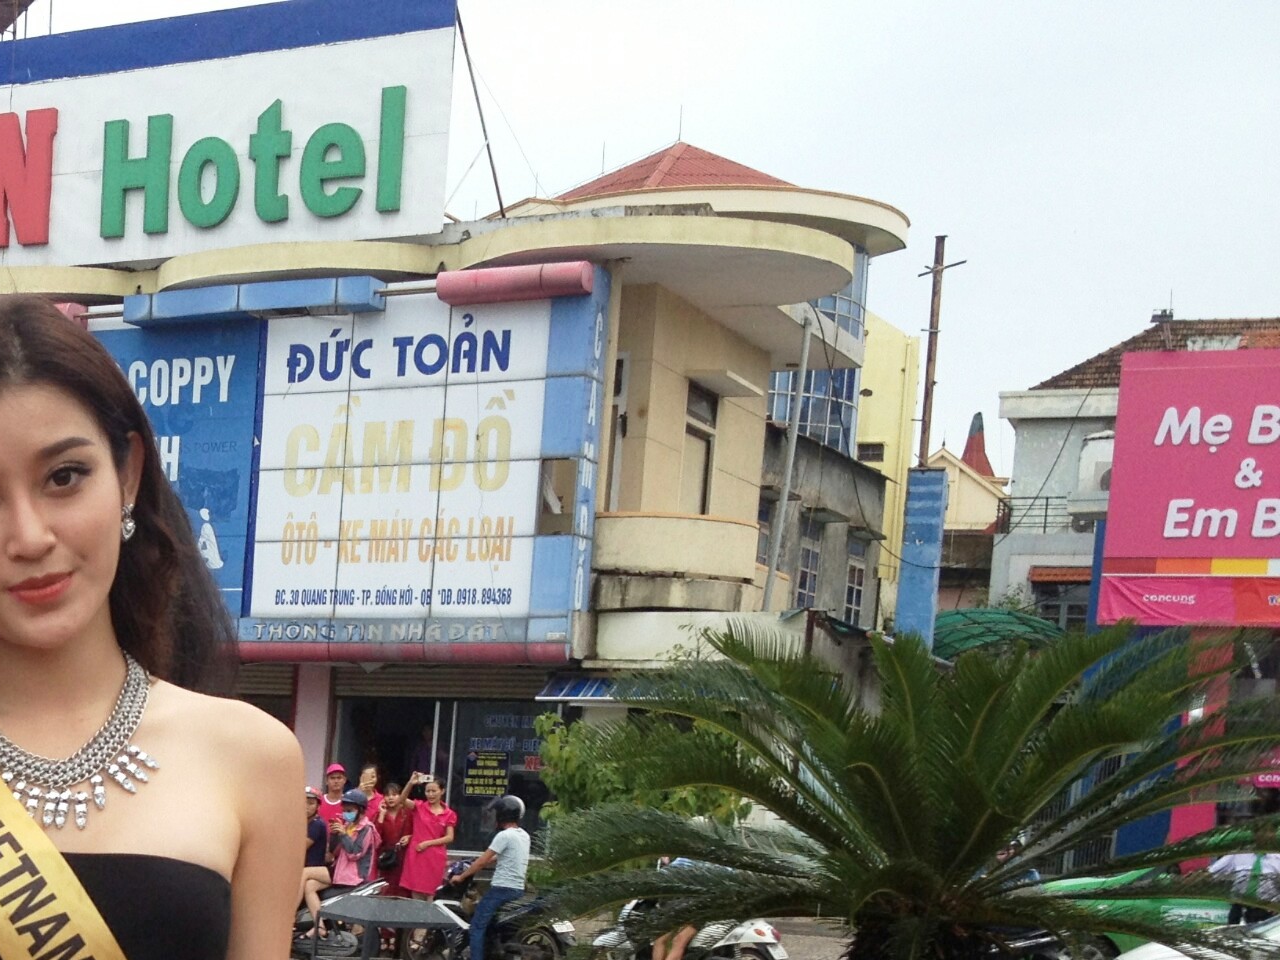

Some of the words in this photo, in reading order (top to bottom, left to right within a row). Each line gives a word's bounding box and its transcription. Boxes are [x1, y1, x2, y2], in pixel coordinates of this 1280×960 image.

[100, 85, 407, 240] Hotel
[286, 328, 374, 384] ĐỨC
[392, 313, 512, 377] TOẢN
[128, 355, 235, 407] COPPY
[283, 395, 415, 498] CẦM
[428, 389, 516, 492] ĐỒ
[1154, 406, 1233, 453] Mẹ
[1234, 457, 1263, 489] &
[281, 511, 319, 566] ÔTÔ
[338, 519, 364, 564] XE
[368, 509, 413, 563] MÁY
[417, 508, 460, 563] CÁC
[466, 516, 514, 572] LOẠI
[1163, 498, 1238, 538] Em
[301, 589, 327, 607] QUANG
[329, 589, 355, 606] TRUNG
